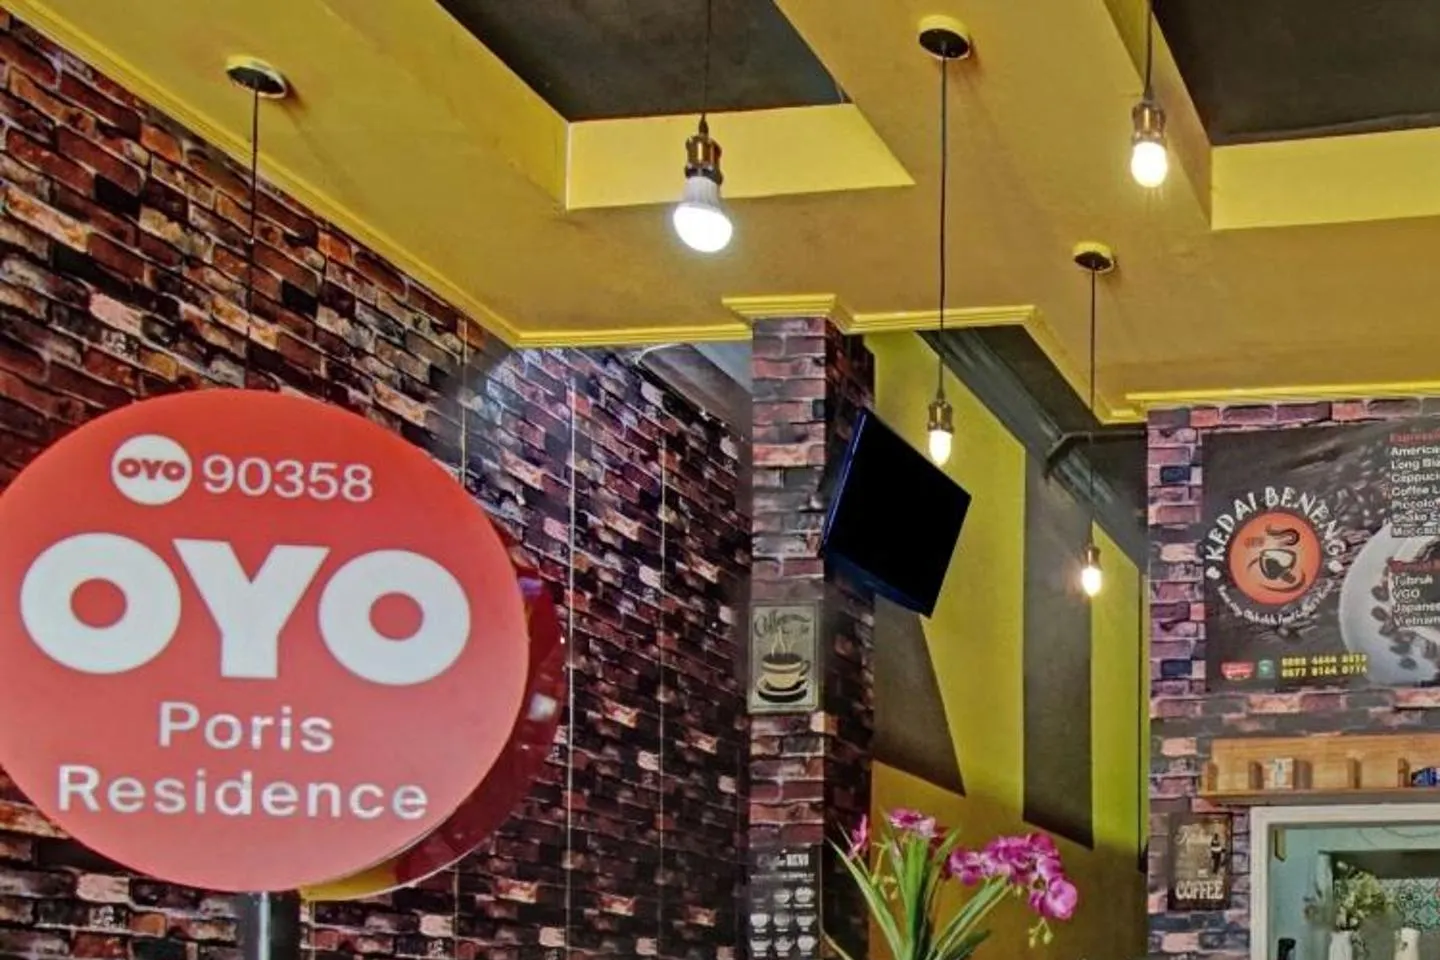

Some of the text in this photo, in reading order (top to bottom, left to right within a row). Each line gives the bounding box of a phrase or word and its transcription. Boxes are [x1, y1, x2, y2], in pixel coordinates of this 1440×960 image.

[117, 454, 374, 503] OYO 90358
[1391, 459, 1420, 471] Long
[1205, 492, 1258, 561] KEDAI
[20, 532, 471, 686] OYO
[1394, 616, 1440, 627] Vietnam
[159, 701, 334, 753] Poris
[58, 764, 428, 821] Residence
[1175, 879, 1224, 900] COFFEE
